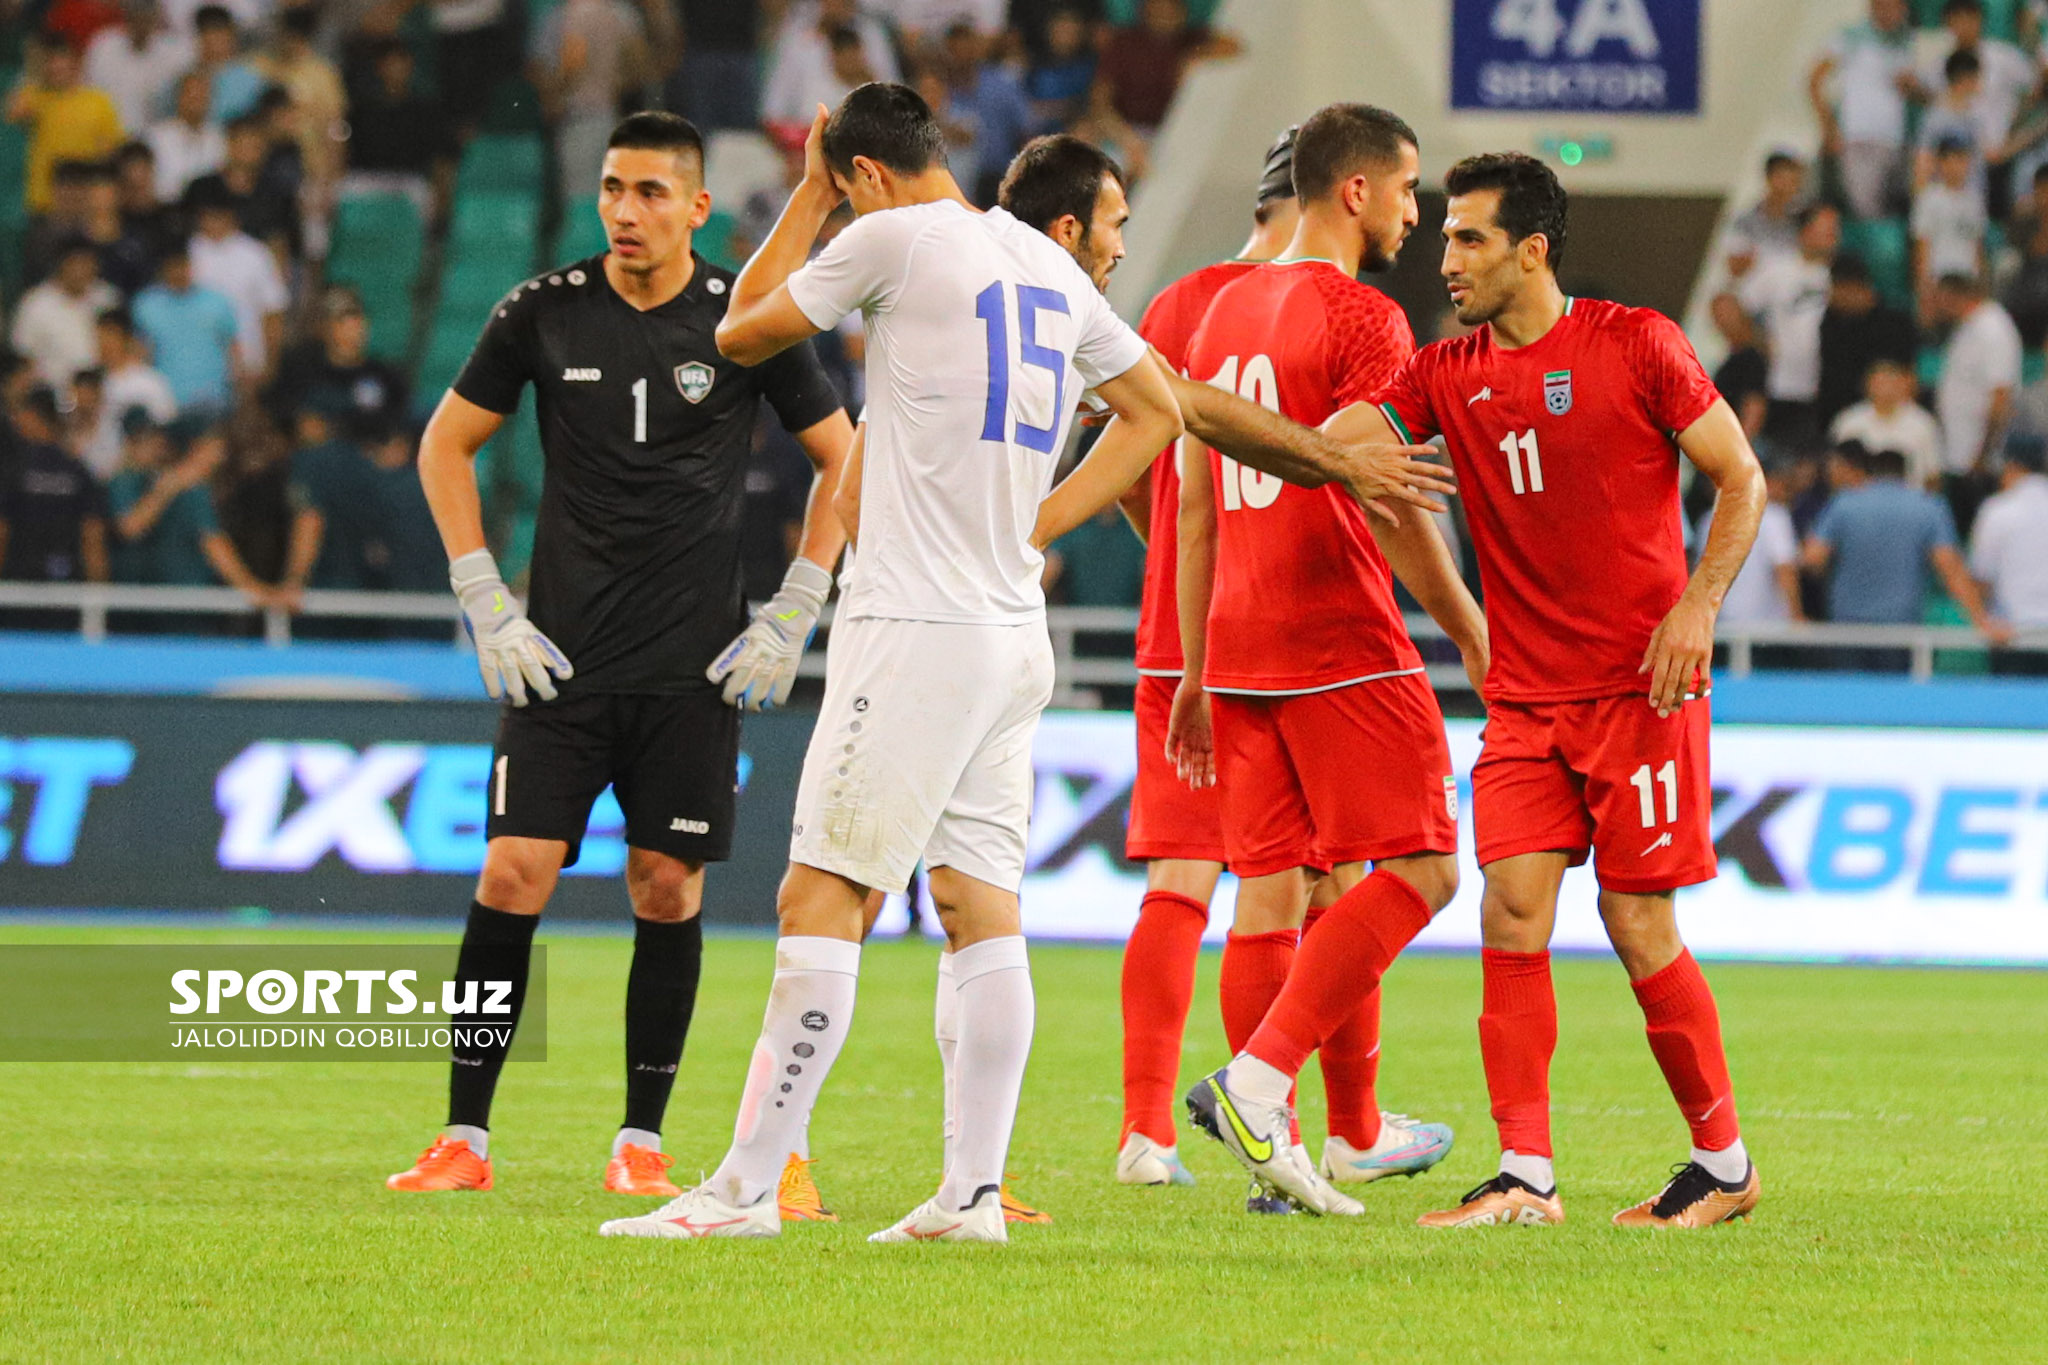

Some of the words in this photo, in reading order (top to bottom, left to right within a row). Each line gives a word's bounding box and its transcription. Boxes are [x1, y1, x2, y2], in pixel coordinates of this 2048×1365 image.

[1490, 0, 1661, 57] 4A
[1478, 61, 1669, 105] SEKTOR
[563, 368, 602, 381] JAKO
[681, 369, 709, 385] UFA
[976, 280, 1072, 455] 15
[632, 378, 647, 442] 1
[1499, 428, 1544, 495] 11
[495, 755, 509, 815] 1
[1630, 760, 1677, 828] 11
[670, 817, 709, 834] JAKO
